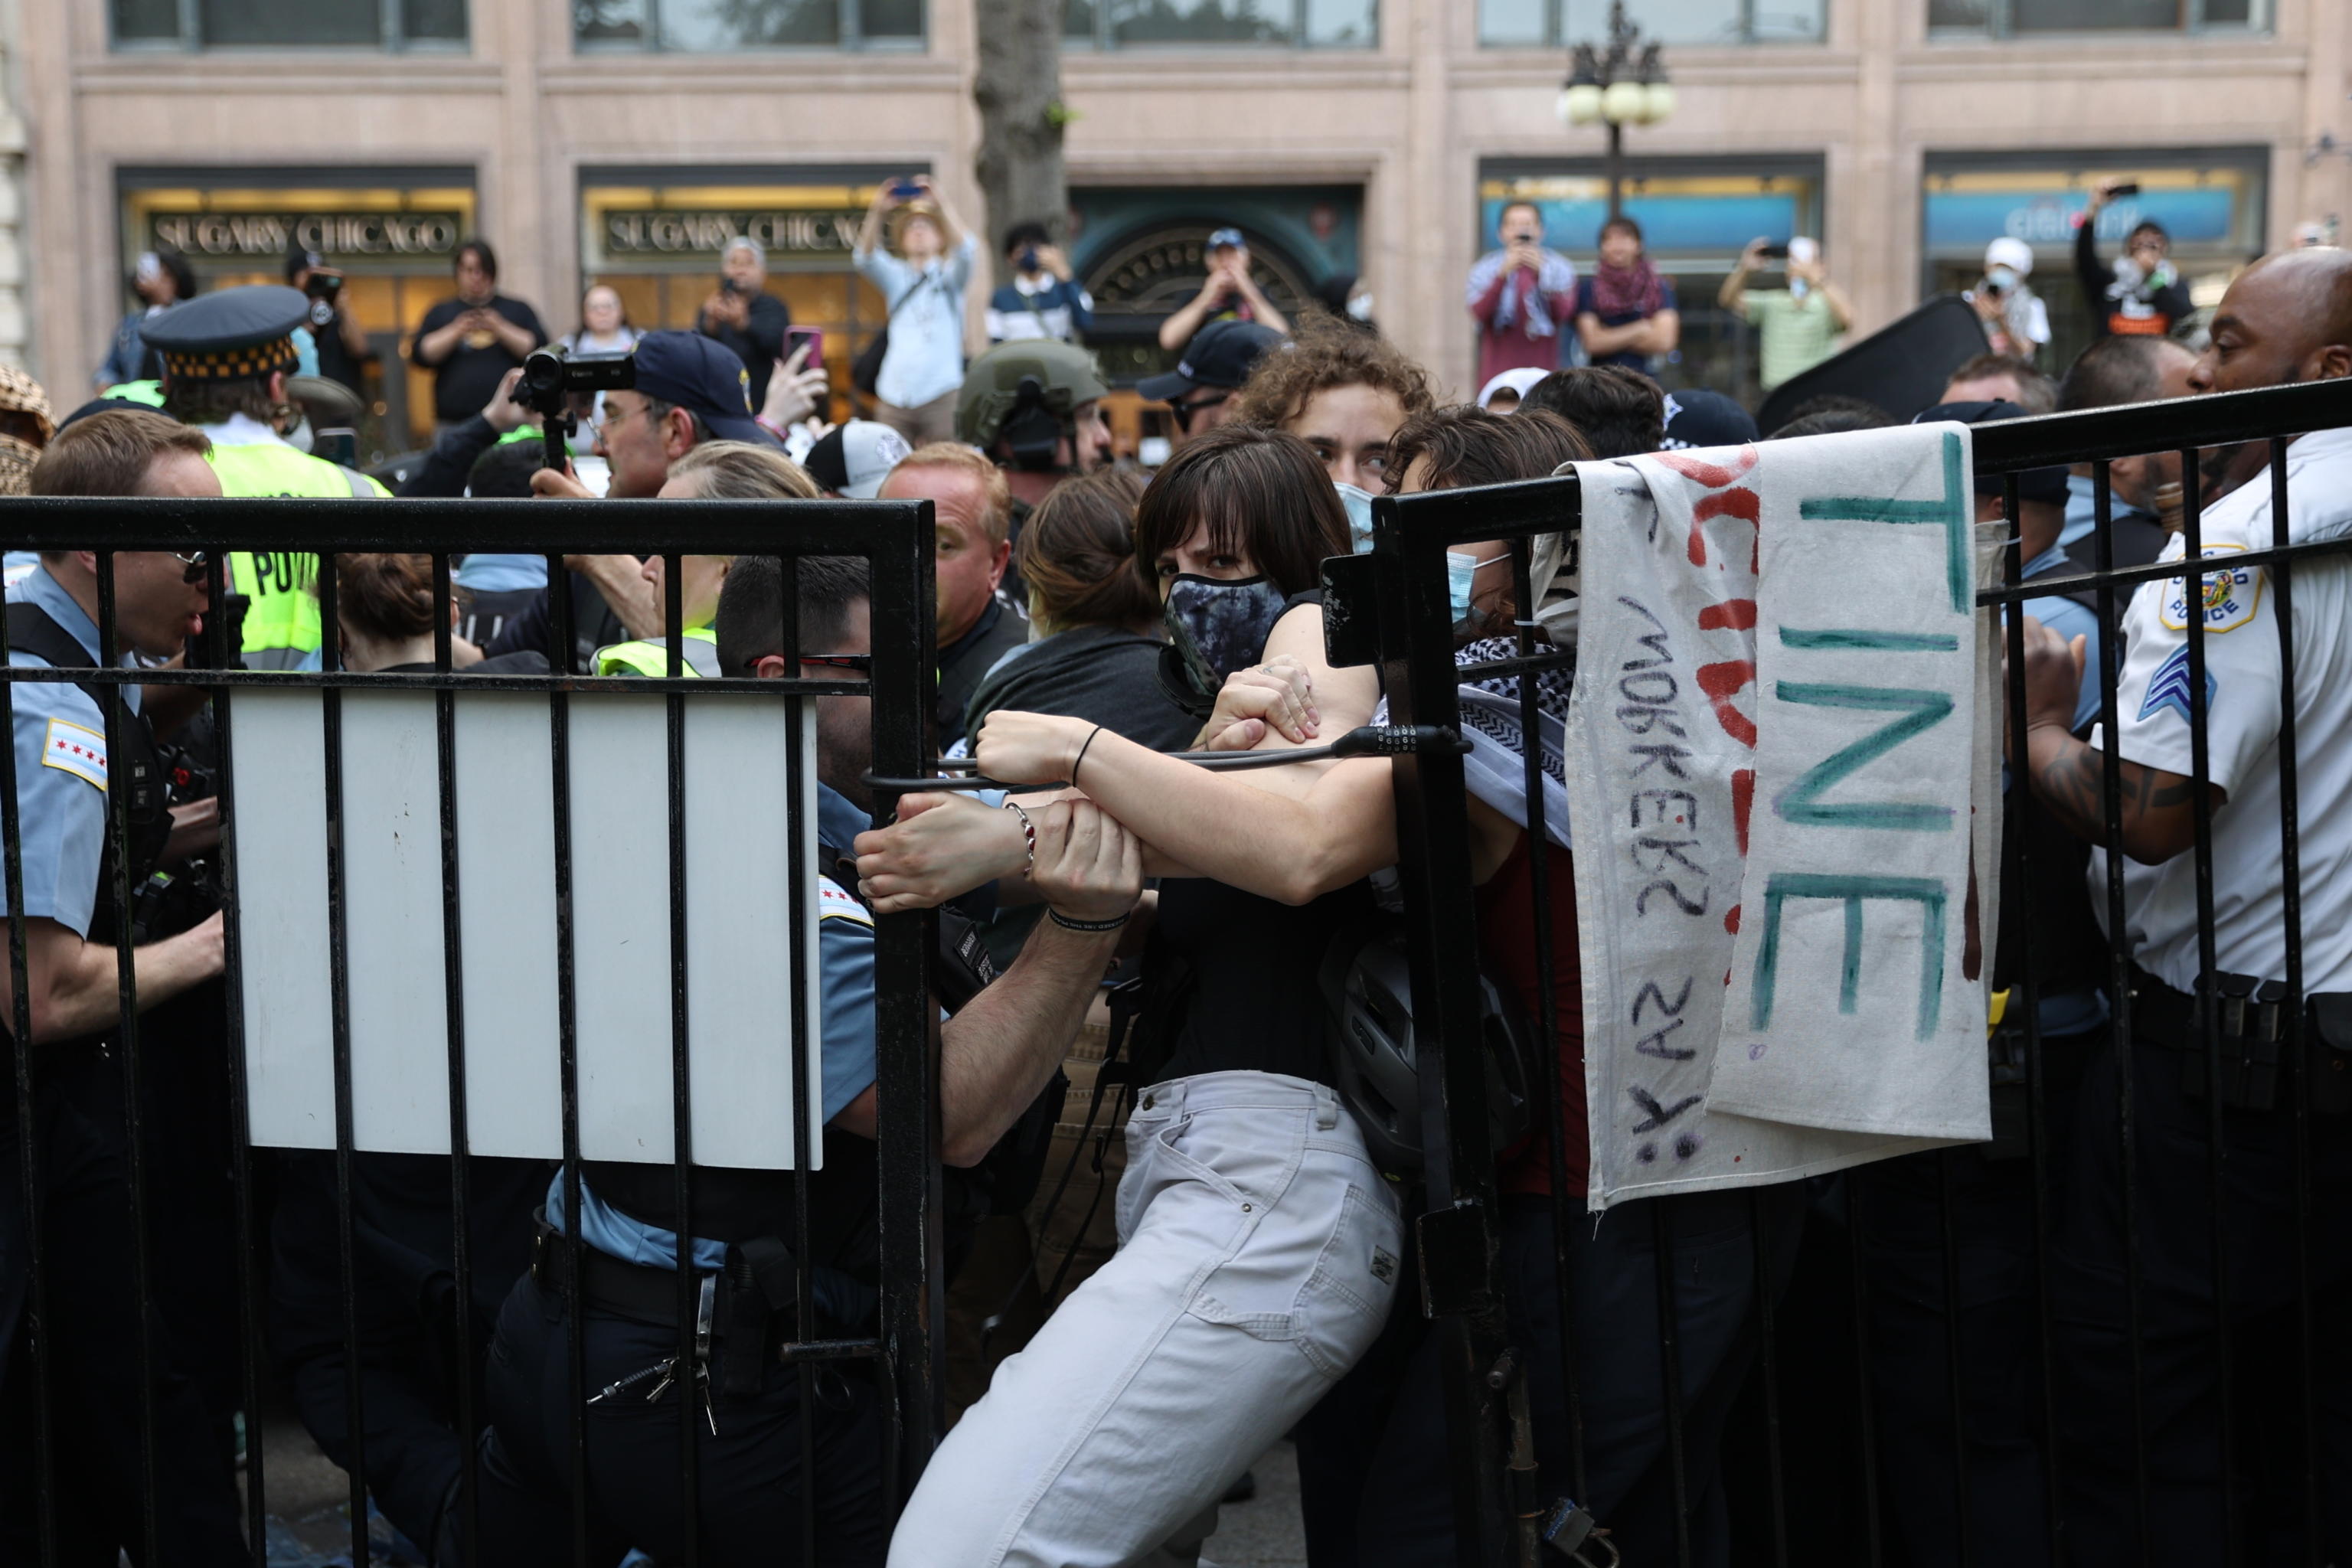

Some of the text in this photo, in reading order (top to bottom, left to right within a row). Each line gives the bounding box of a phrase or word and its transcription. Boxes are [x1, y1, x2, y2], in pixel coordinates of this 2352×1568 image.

[155, 214, 456, 253] SUGARY CHICAGO
[2170, 598, 2239, 622] POICE
[1748, 432, 1966, 1040] TINE
